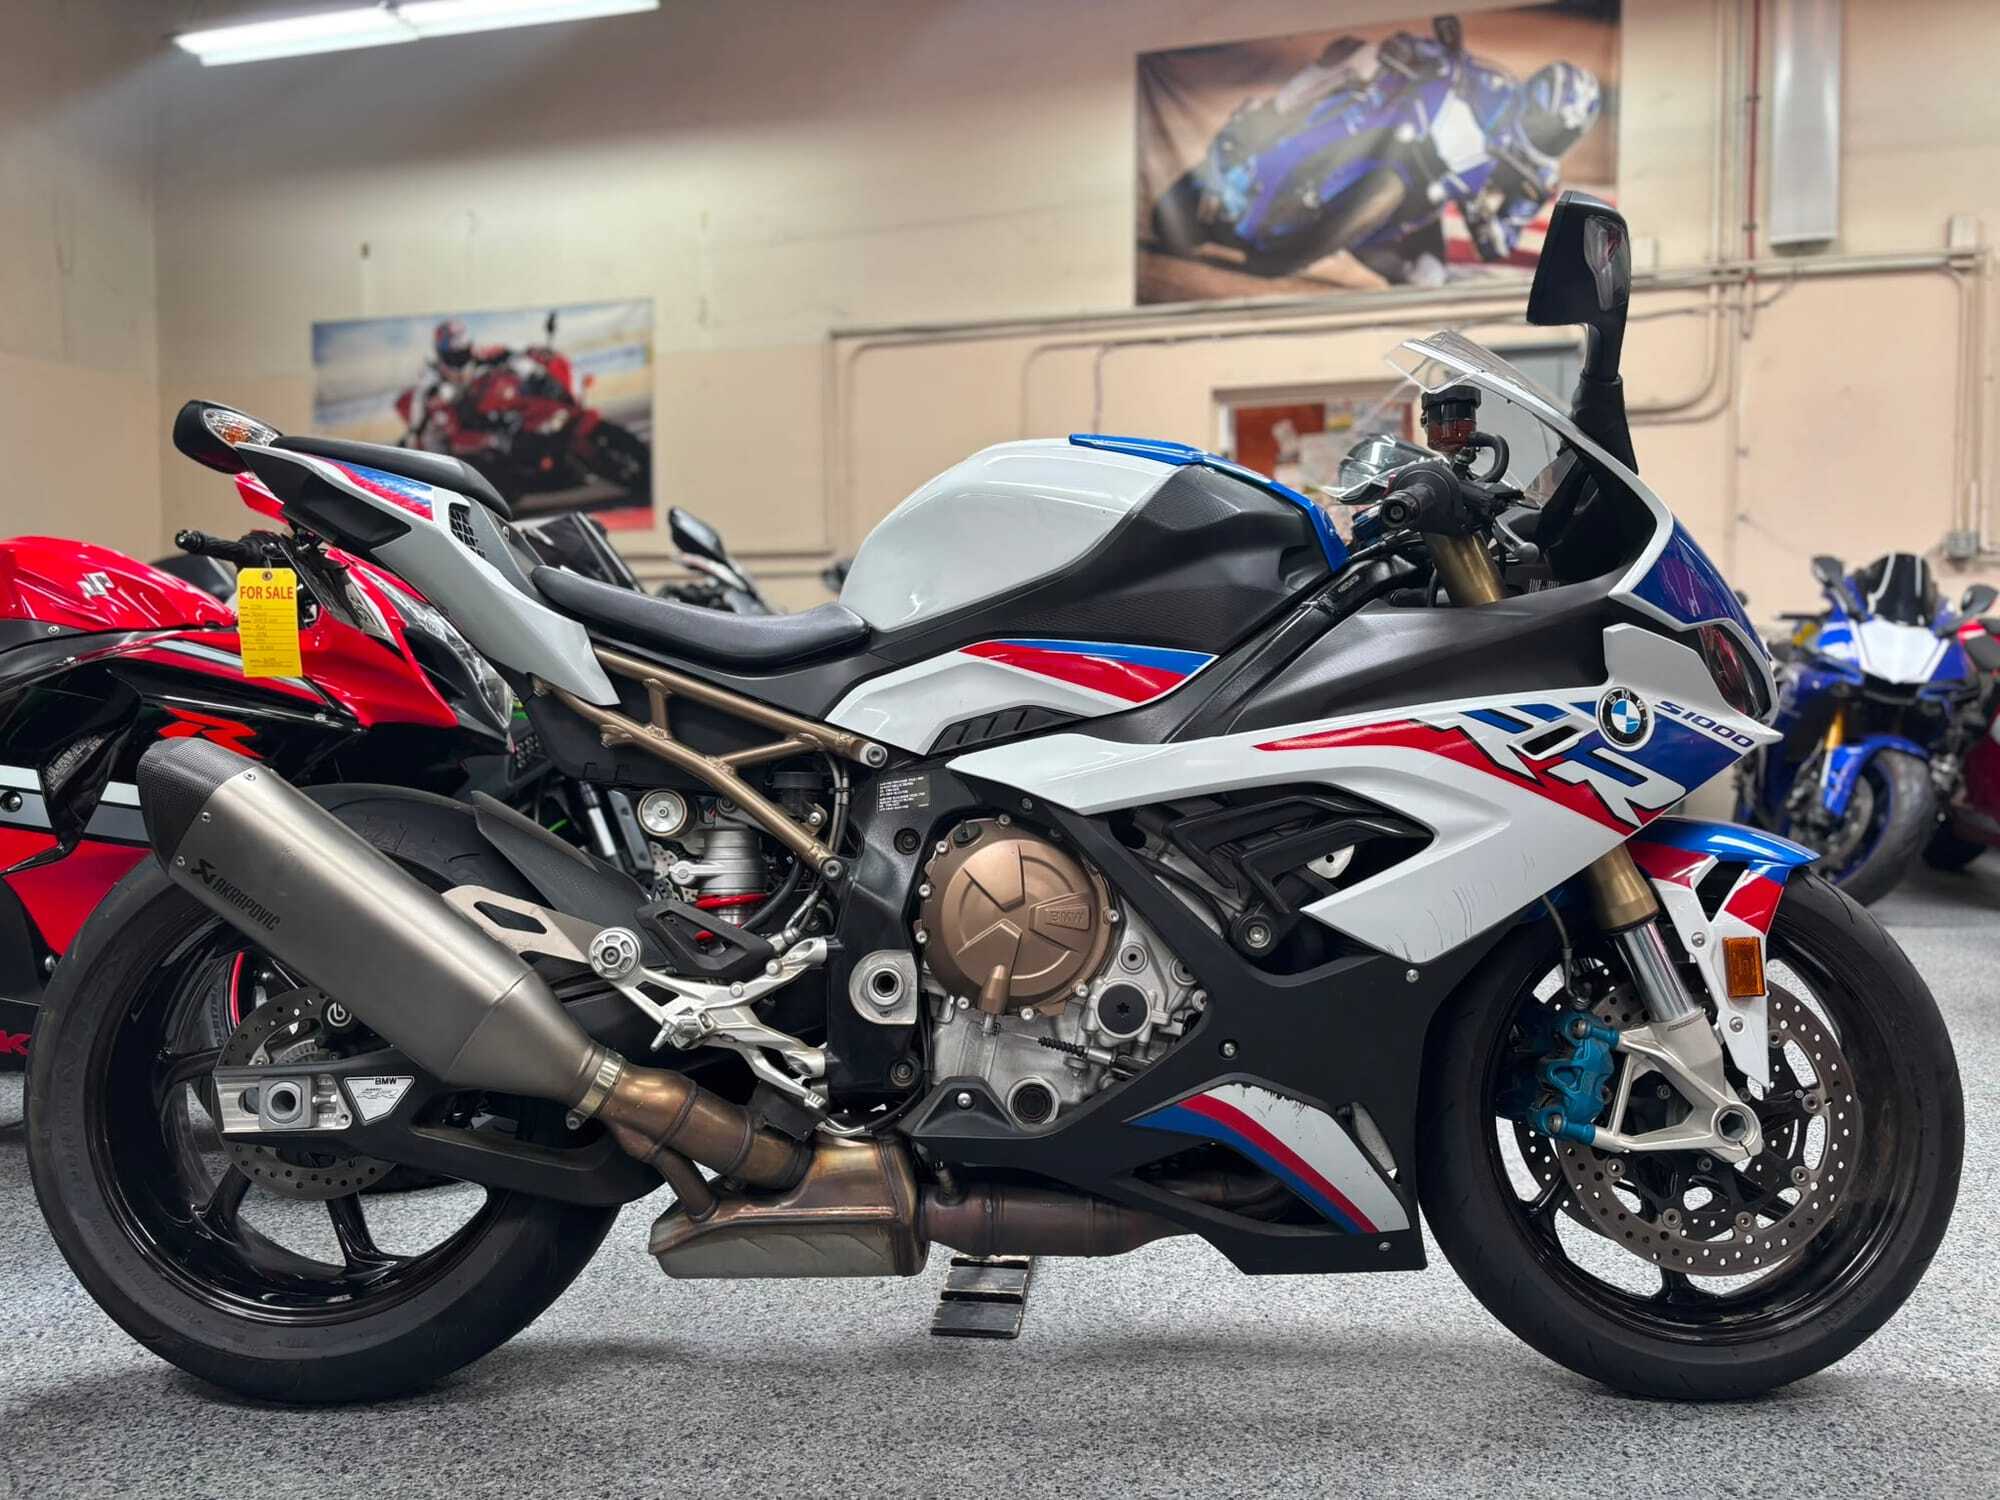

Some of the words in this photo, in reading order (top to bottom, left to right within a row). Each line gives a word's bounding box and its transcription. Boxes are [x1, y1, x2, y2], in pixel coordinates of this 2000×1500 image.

[240, 586, 262, 600] FOR
[266, 586, 294, 600] SALE
[1654, 700, 1755, 748] S1000
[1050, 911, 1083, 923] BMW
[374, 1077, 398, 1085] BMW
